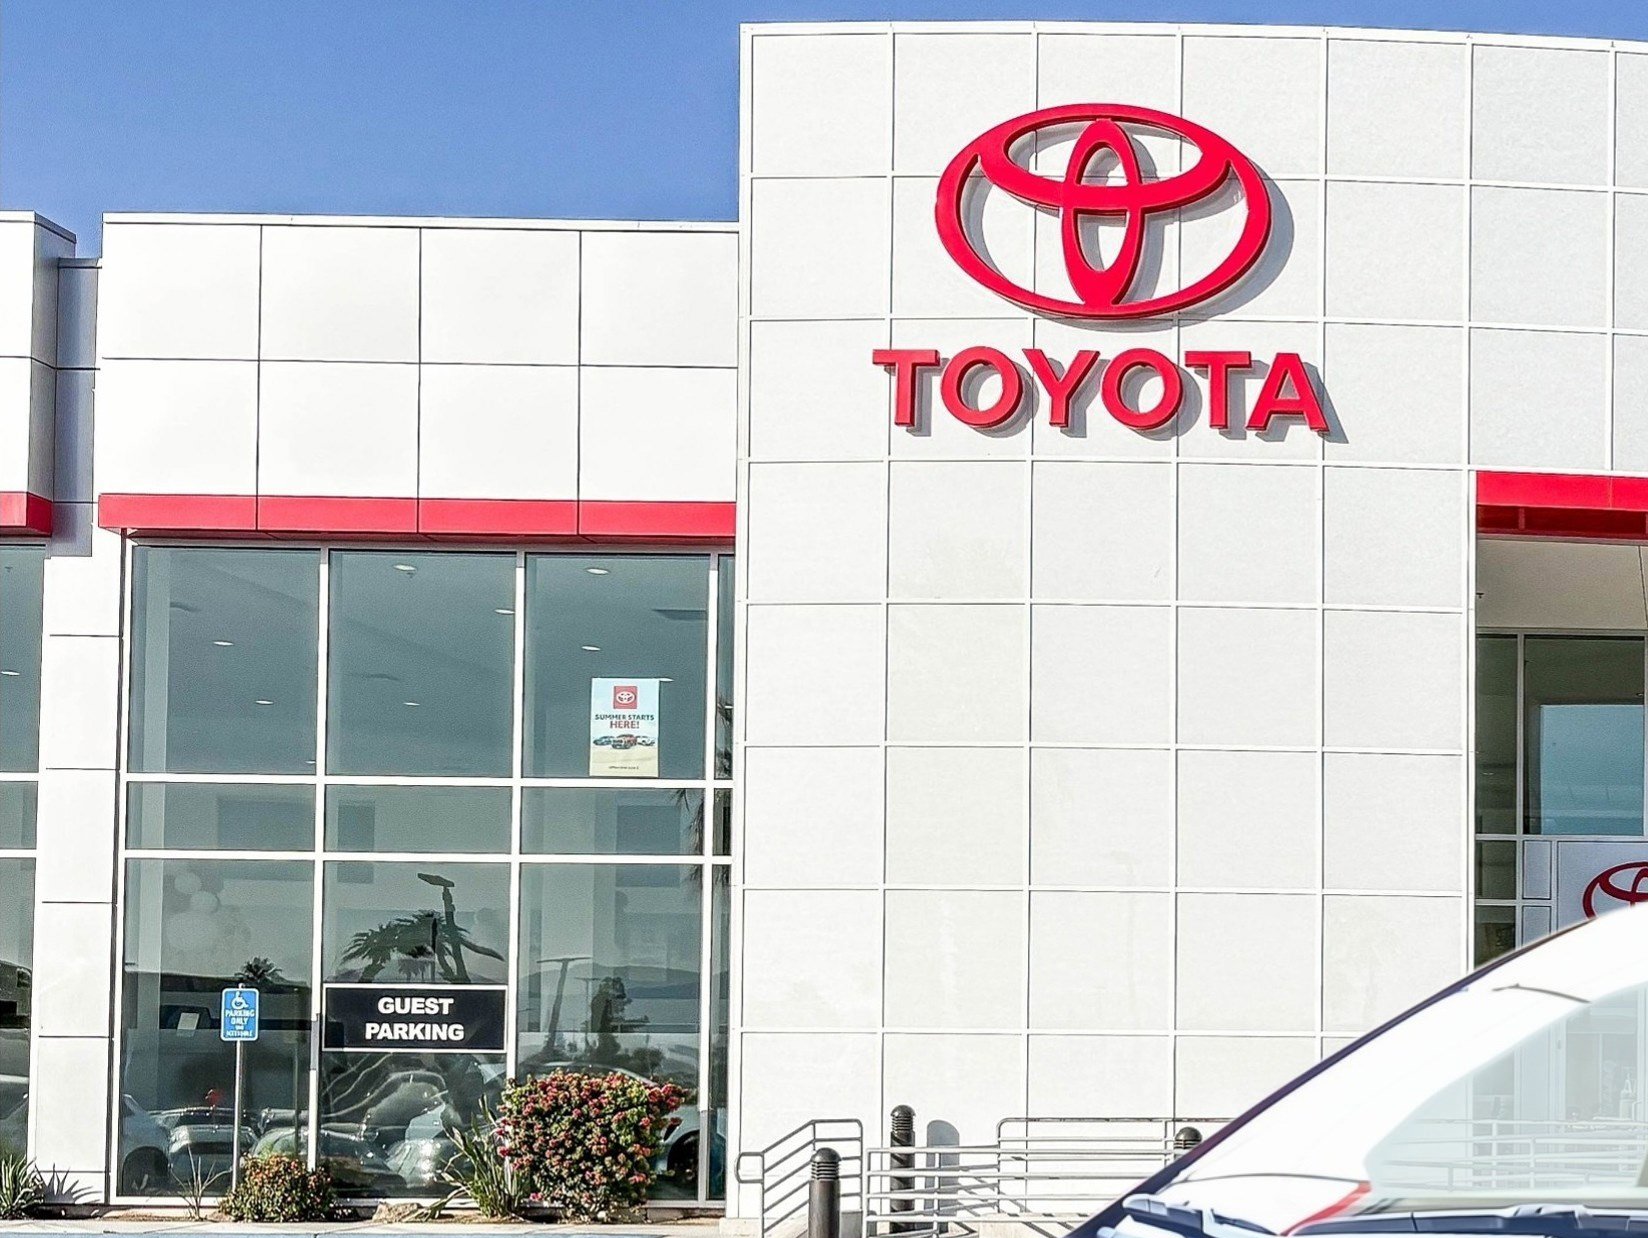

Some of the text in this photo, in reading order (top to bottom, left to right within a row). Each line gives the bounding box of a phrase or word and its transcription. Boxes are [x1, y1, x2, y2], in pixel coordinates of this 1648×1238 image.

[872, 346, 1330, 432] TOYOTA
[609, 720, 640, 729] HERE!
[377, 997, 455, 1015] GUEST
[365, 1022, 464, 1041] PARKING
